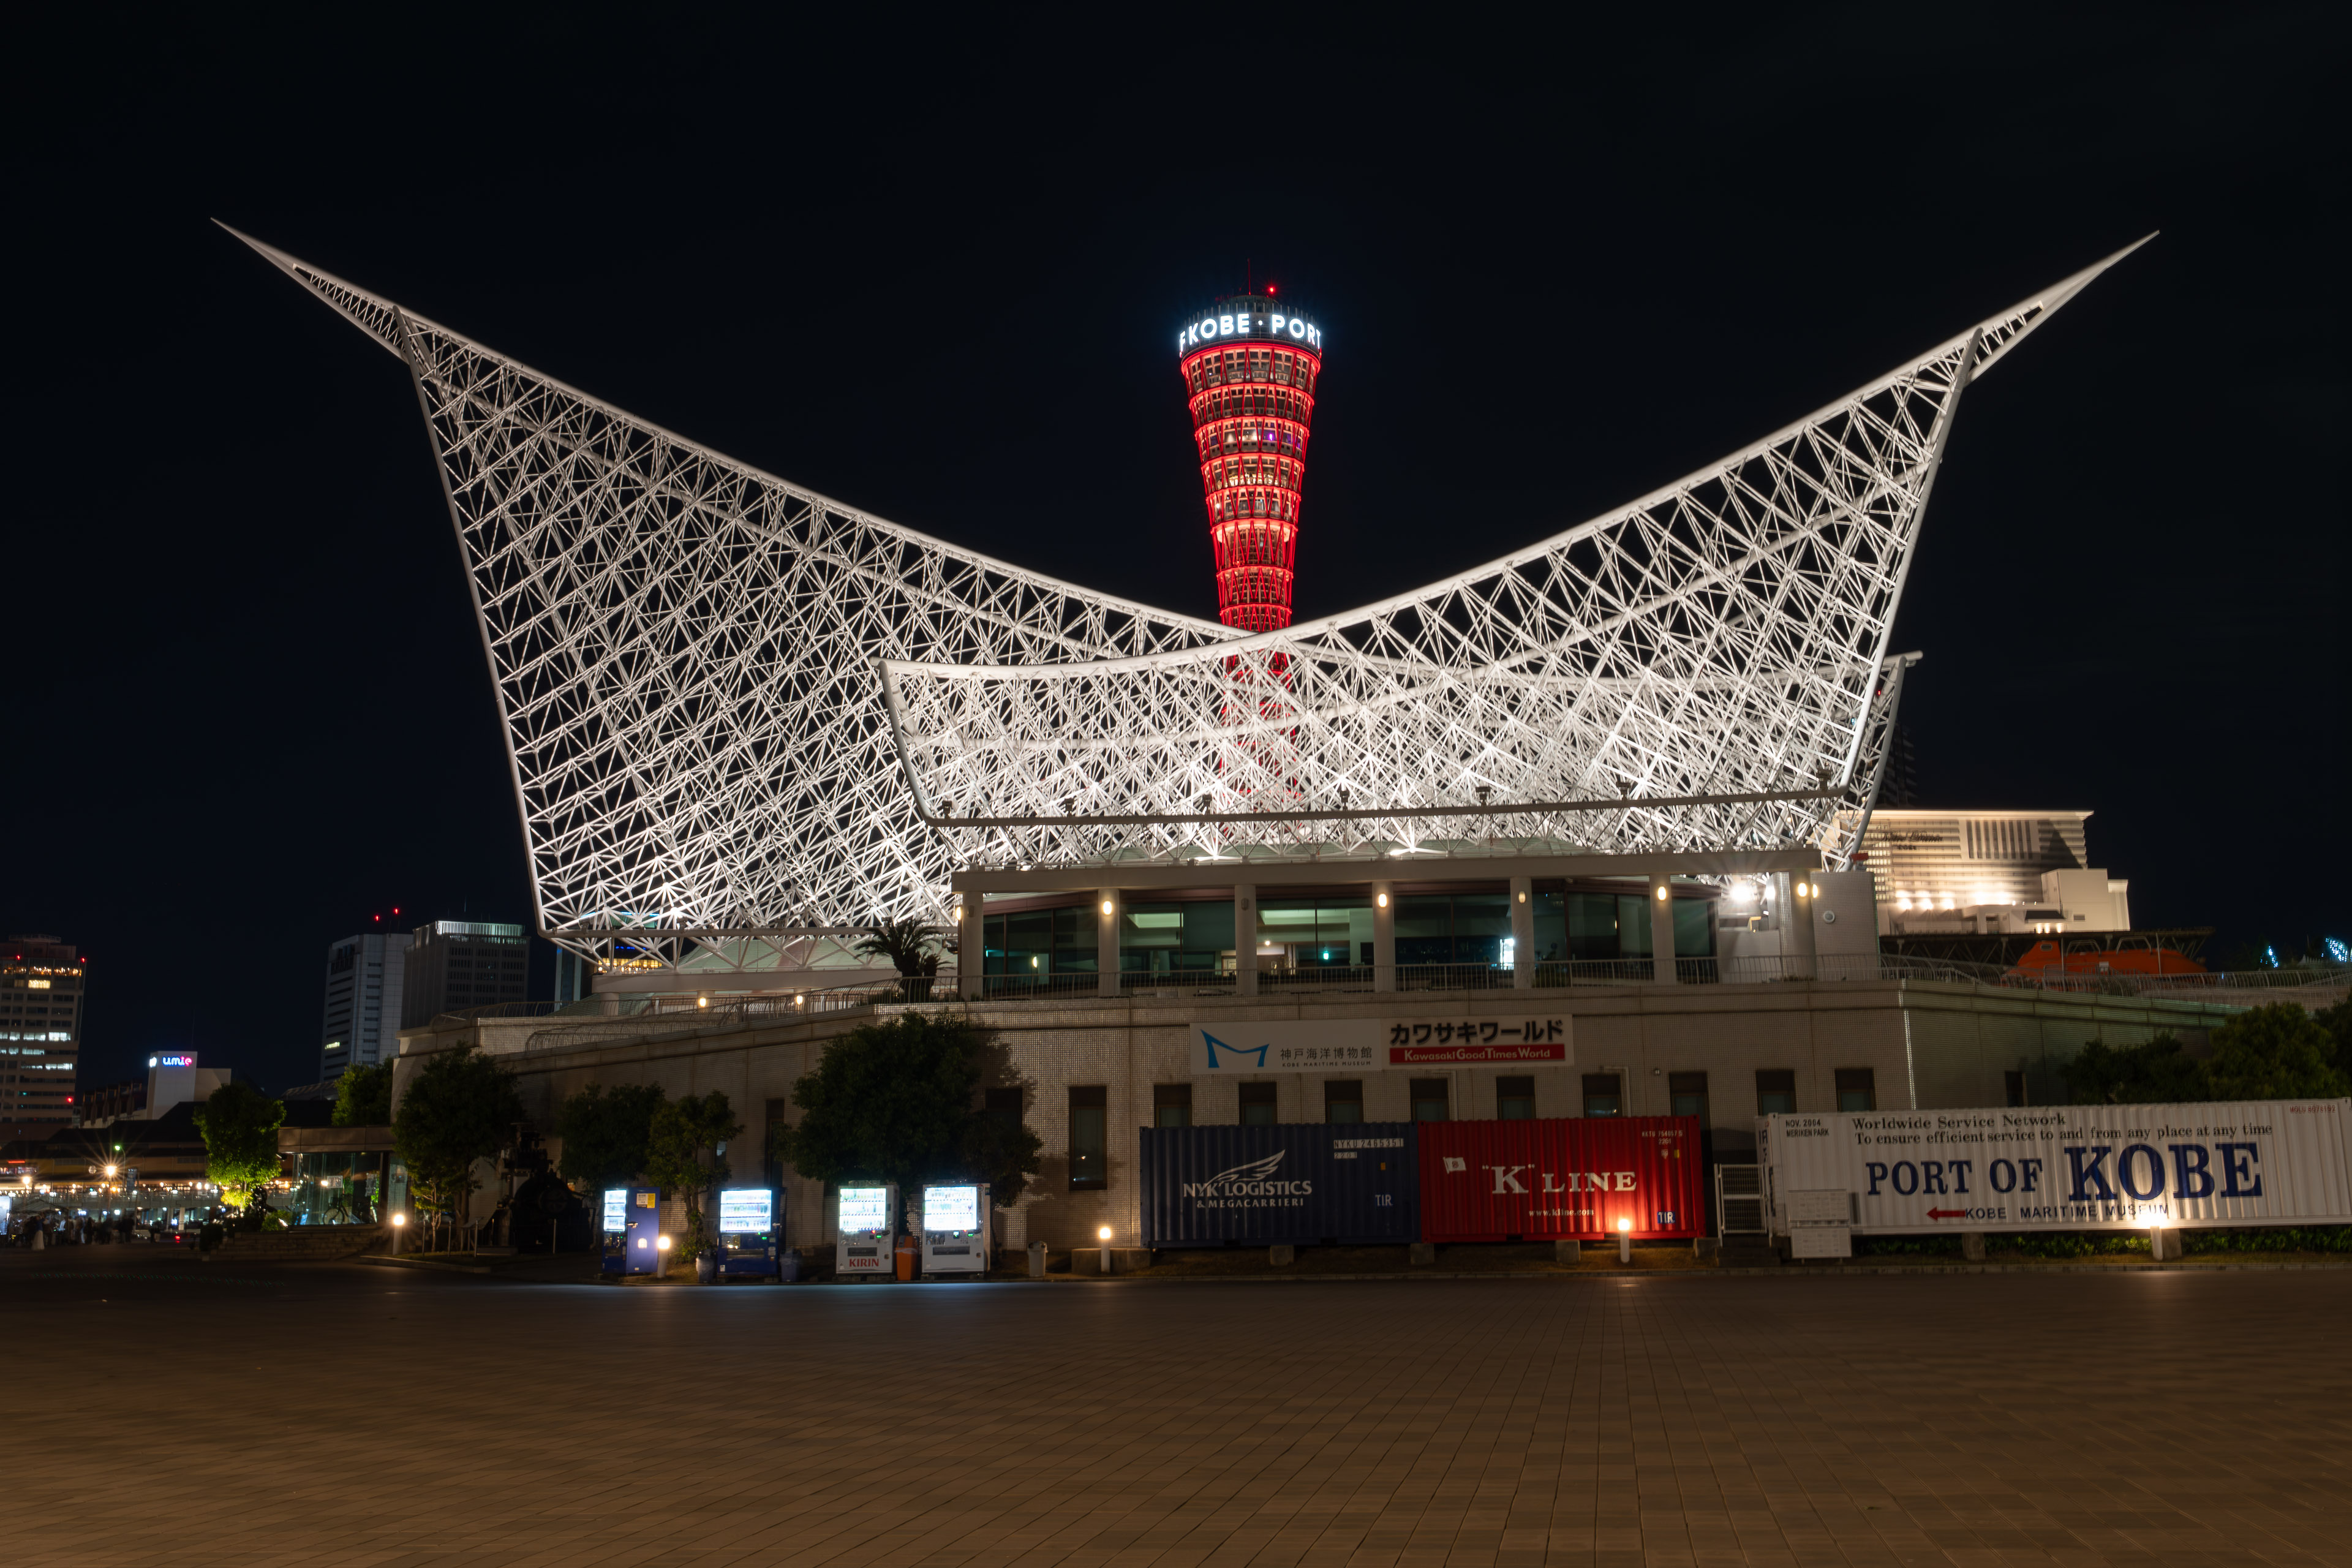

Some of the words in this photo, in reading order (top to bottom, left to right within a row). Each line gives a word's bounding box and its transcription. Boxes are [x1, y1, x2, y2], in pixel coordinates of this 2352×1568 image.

[1188, 313, 1250, 345] KOBE
[1272, 314, 1321, 349] PORT
[1390, 1020, 1563, 1045] カワサキワールド
[1280, 1047, 1373, 1060] 神戸海洋博物館
[1404, 1049, 1455, 1061] Kawasaki
[1457, 1048, 1485, 1060] Good
[1485, 1047, 1517, 1059] Times
[1518, 1047, 1550, 1058] World
[162, 1056, 192, 1067] umie
[1785, 1119, 1801, 1128] NOV.
[1803, 1118, 1821, 1127] 2004
[1852, 1116, 1931, 1130] Worldwide
[1937, 1115, 1995, 1128] Service
[2003, 1113, 2065, 1126] Network
[1787, 1129, 1812, 1137] MERIKEN
[1814, 1128, 1829, 1137] PARK
[1855, 1132, 1871, 1144] To
[1876, 1134, 1921, 1144] ensure
[1926, 1131, 1985, 1143] efficient
[1988, 1129, 2035, 1142] service
[2040, 1129, 2054, 1140] to
[2060, 1127, 2084, 1139] and
[2090, 1126, 2122, 1139] from
[2128, 1128, 2151, 1140] any
[2157, 1124, 2192, 1140] place
[2197, 1125, 2210, 1136] at
[2213, 1125, 2237, 1139] any
[2242, 1122, 2272, 1135] time
[1866, 1159, 1972, 1195] PORT
[1989, 1158, 2043, 1193] OF
[2064, 1142, 2263, 1200] KOBE
[1183, 1183, 1218, 1197] NYK
[1224, 1180, 1313, 1196] LOGISTICS
[1542, 1172, 1637, 1193] LINE
[1197, 1200, 1205, 1208] &
[1208, 1198, 1304, 1208] MEGACARRIERI
[1375, 1194, 1393, 1207] TIR
[1658, 1212, 1675, 1224] TIR
[1965, 1207, 2007, 1220] KOBE
[2020, 1205, 2097, 1219] MARITIME
[2105, 1204, 2169, 1216] MUSEUM
[850, 1259, 880, 1267] KIRIN
